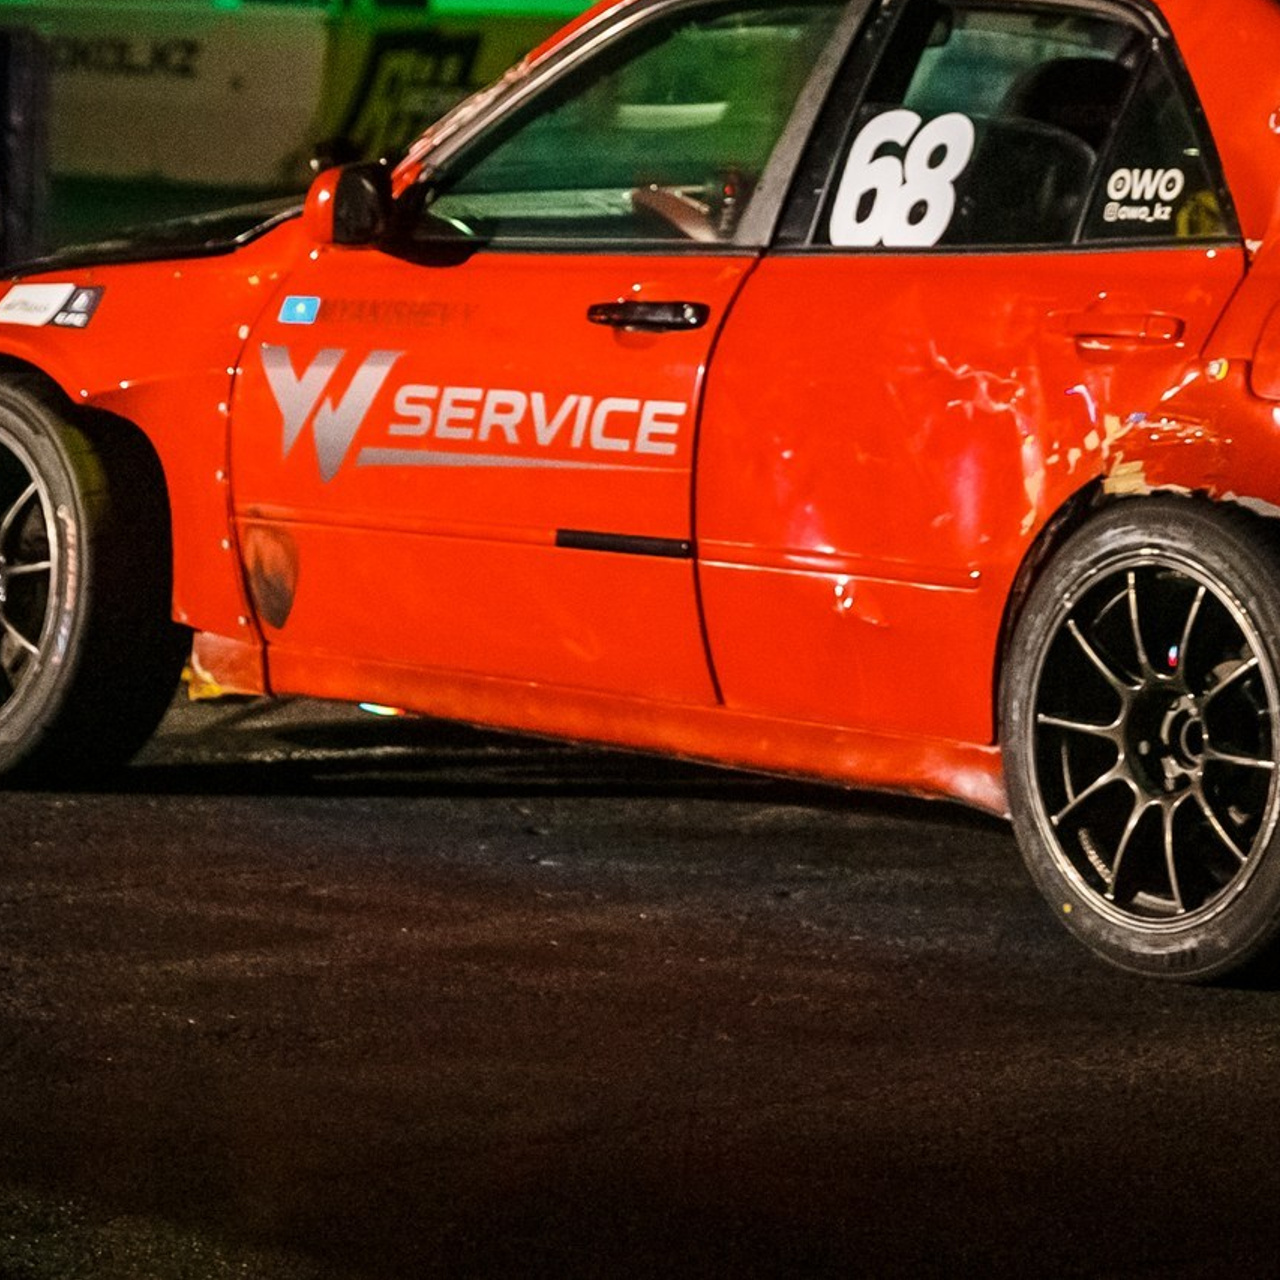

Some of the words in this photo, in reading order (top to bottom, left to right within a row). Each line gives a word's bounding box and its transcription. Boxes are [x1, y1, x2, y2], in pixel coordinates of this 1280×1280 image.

[829, 108, 975, 247] 68
[1106, 167, 1185, 202] OWO
[388, 383, 688, 456] SERVICE
